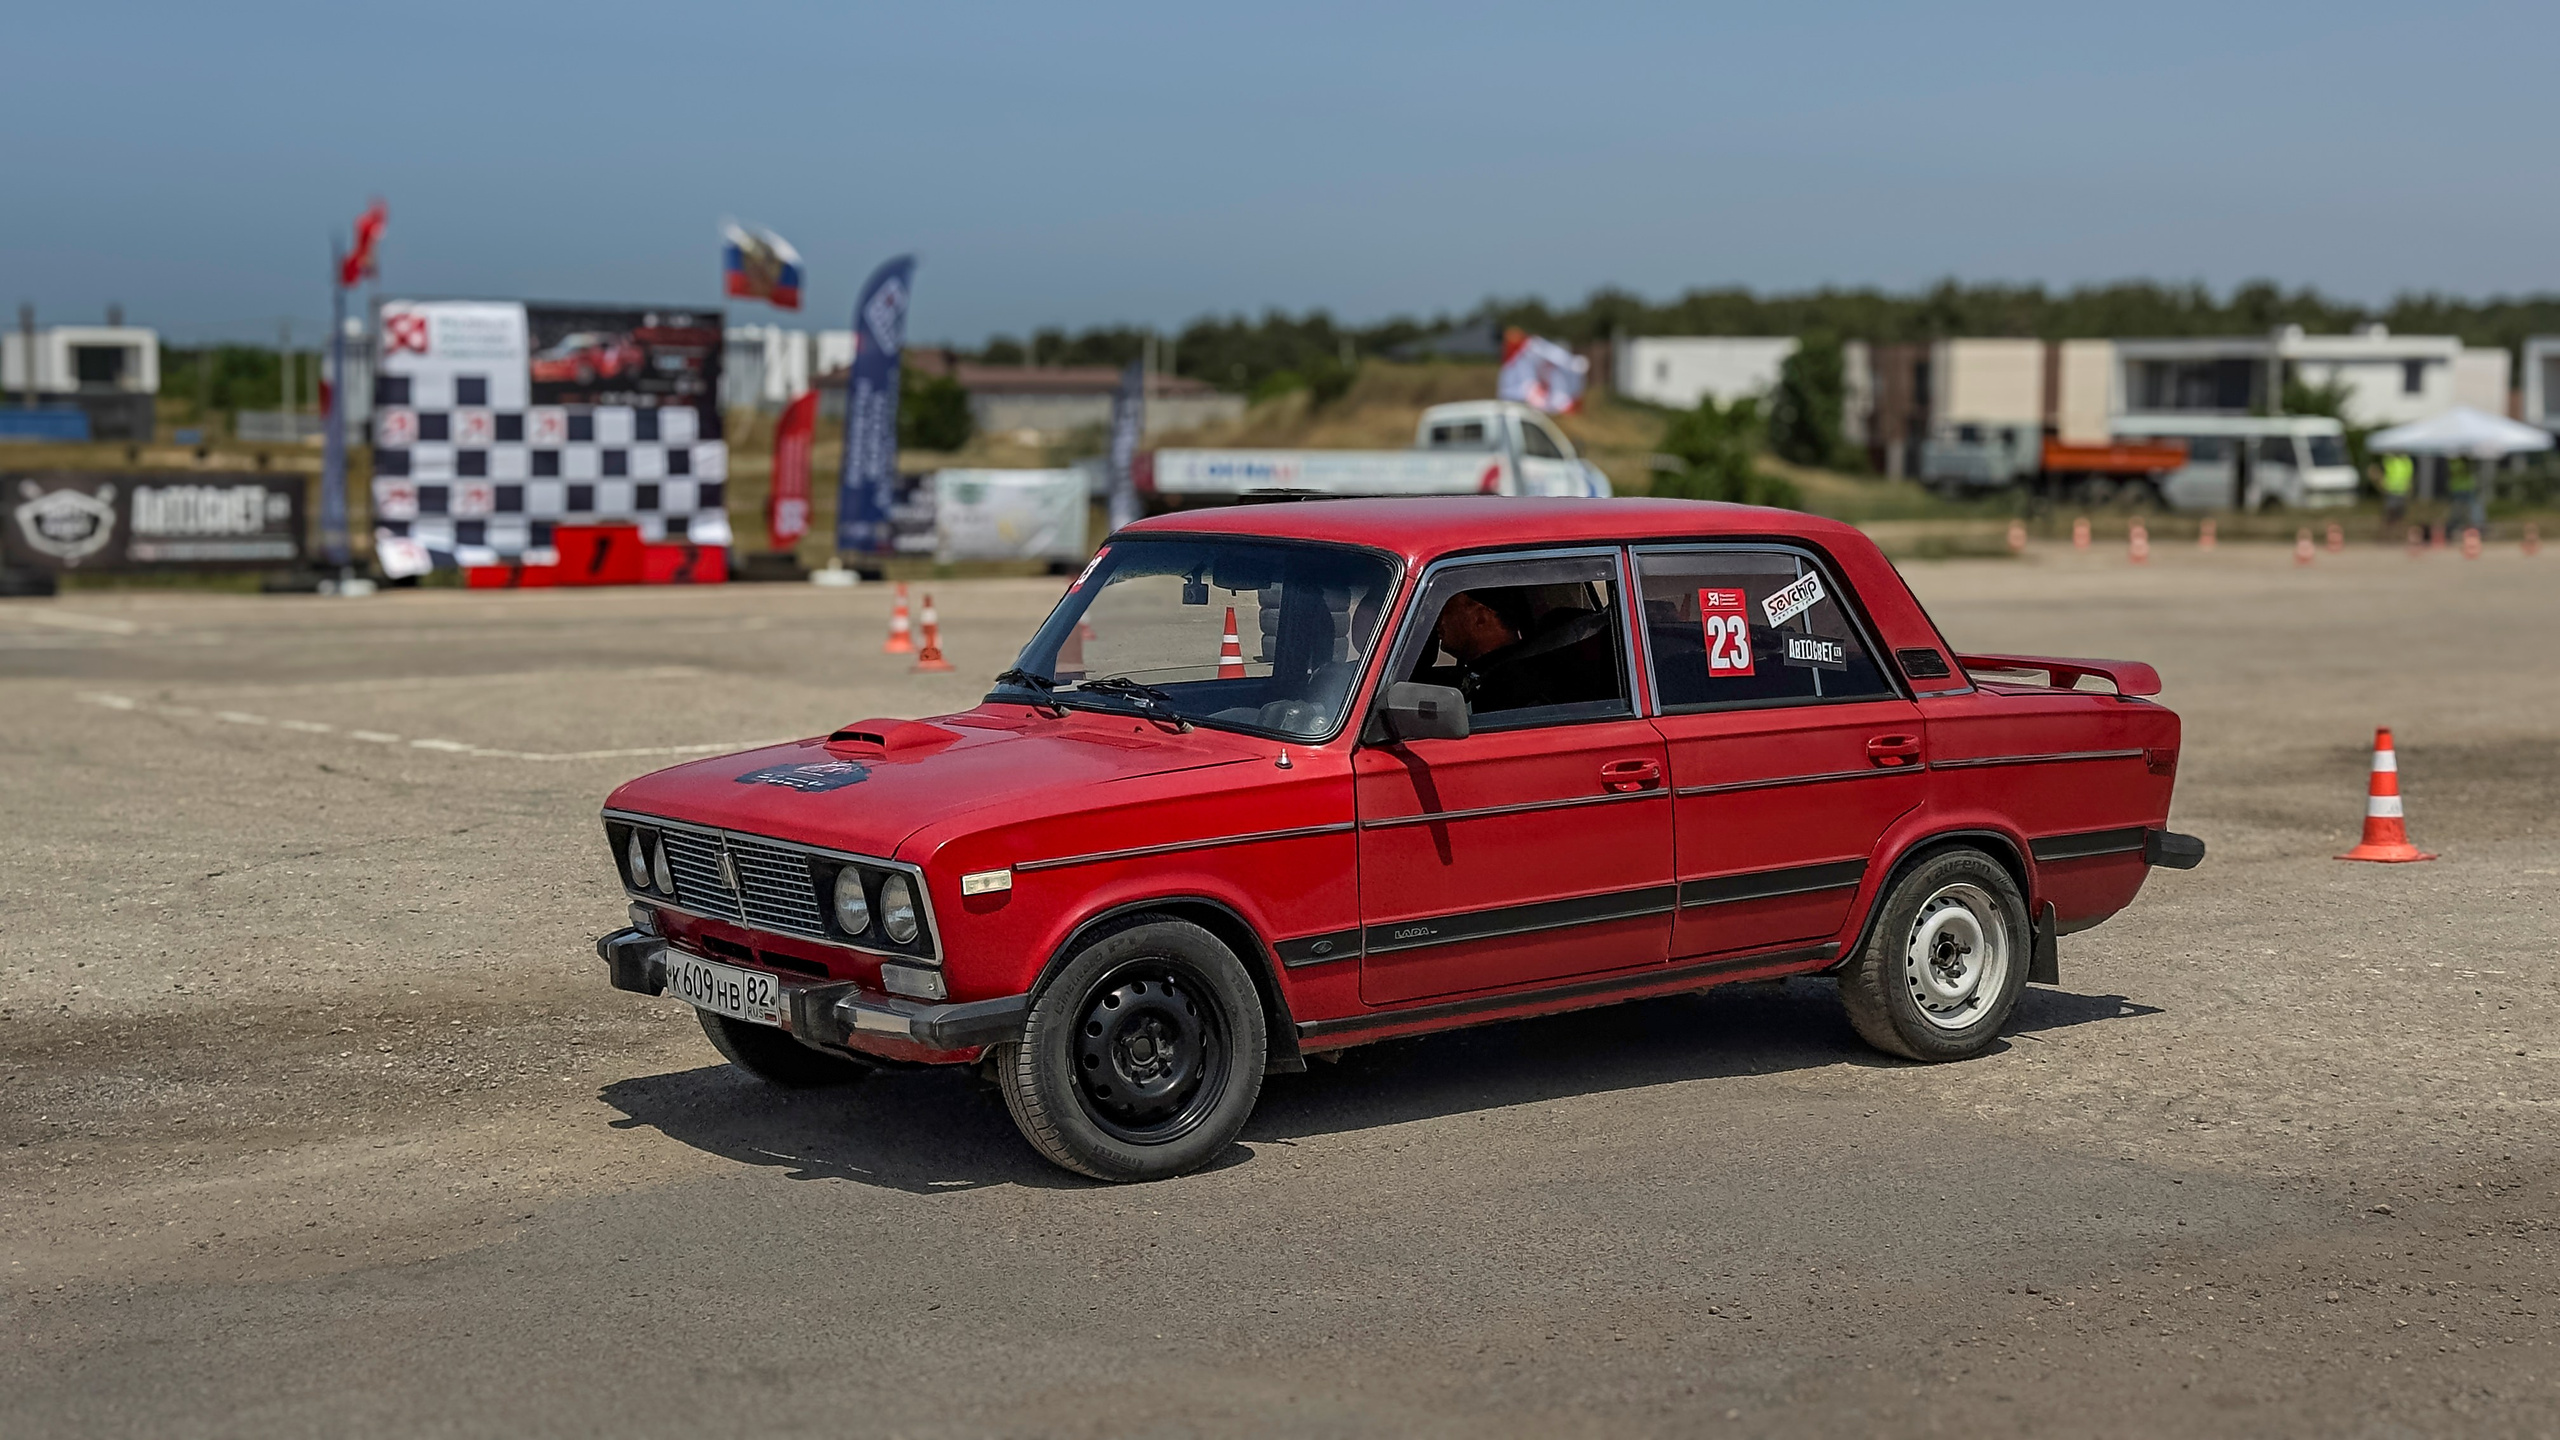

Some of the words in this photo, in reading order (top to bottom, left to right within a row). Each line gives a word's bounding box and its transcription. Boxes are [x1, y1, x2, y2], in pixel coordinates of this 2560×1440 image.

[1707, 615, 1749, 669] 23
[1789, 639, 1833, 662] АВТОСВЕТ
[1395, 927, 1429, 939] LADA
[747, 977, 769, 1007] 82
[747, 1007, 764, 1018] RUS
